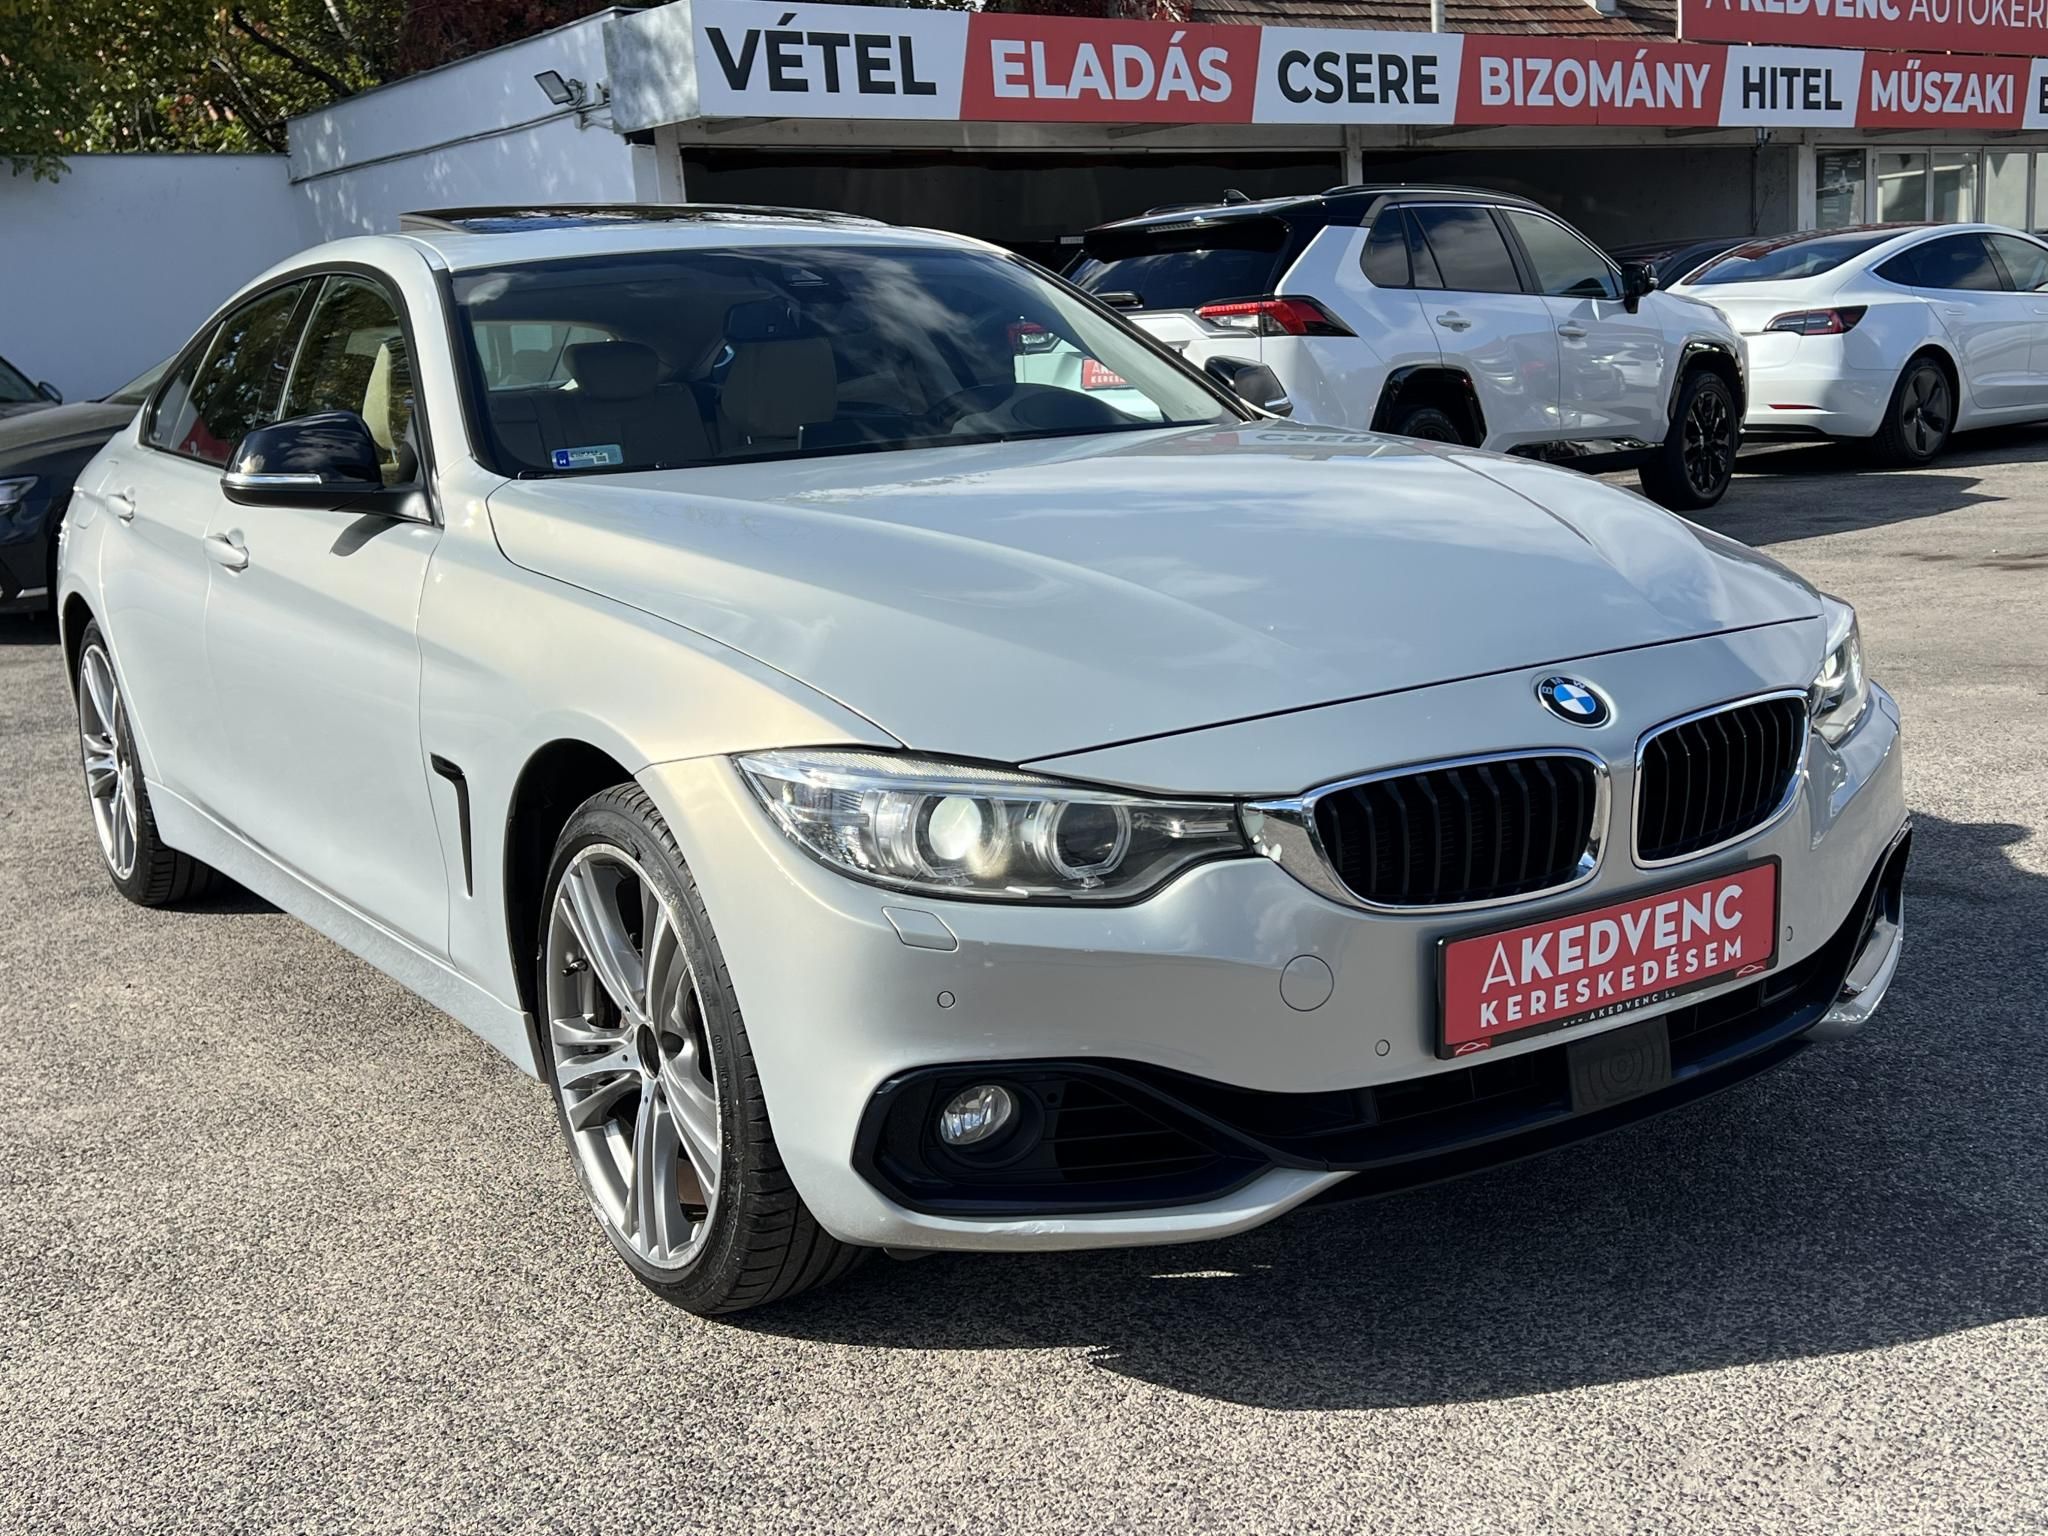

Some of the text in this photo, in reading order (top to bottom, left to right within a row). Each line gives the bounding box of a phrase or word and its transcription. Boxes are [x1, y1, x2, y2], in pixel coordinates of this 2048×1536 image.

[705, 12, 937, 96] VÉTEL
[990, 30, 1233, 103] ELADÁS
[1277, 49, 1440, 104] CSERE
[1479, 48, 1711, 109] BIZOMÁNY
[1742, 66, 1843, 111] HITEL
[1871, 60, 2014, 114] MŰSZAKI
[1541, 676, 1586, 695] BMW
[1480, 936, 1743, 1029] KERESKEDÉSEM
